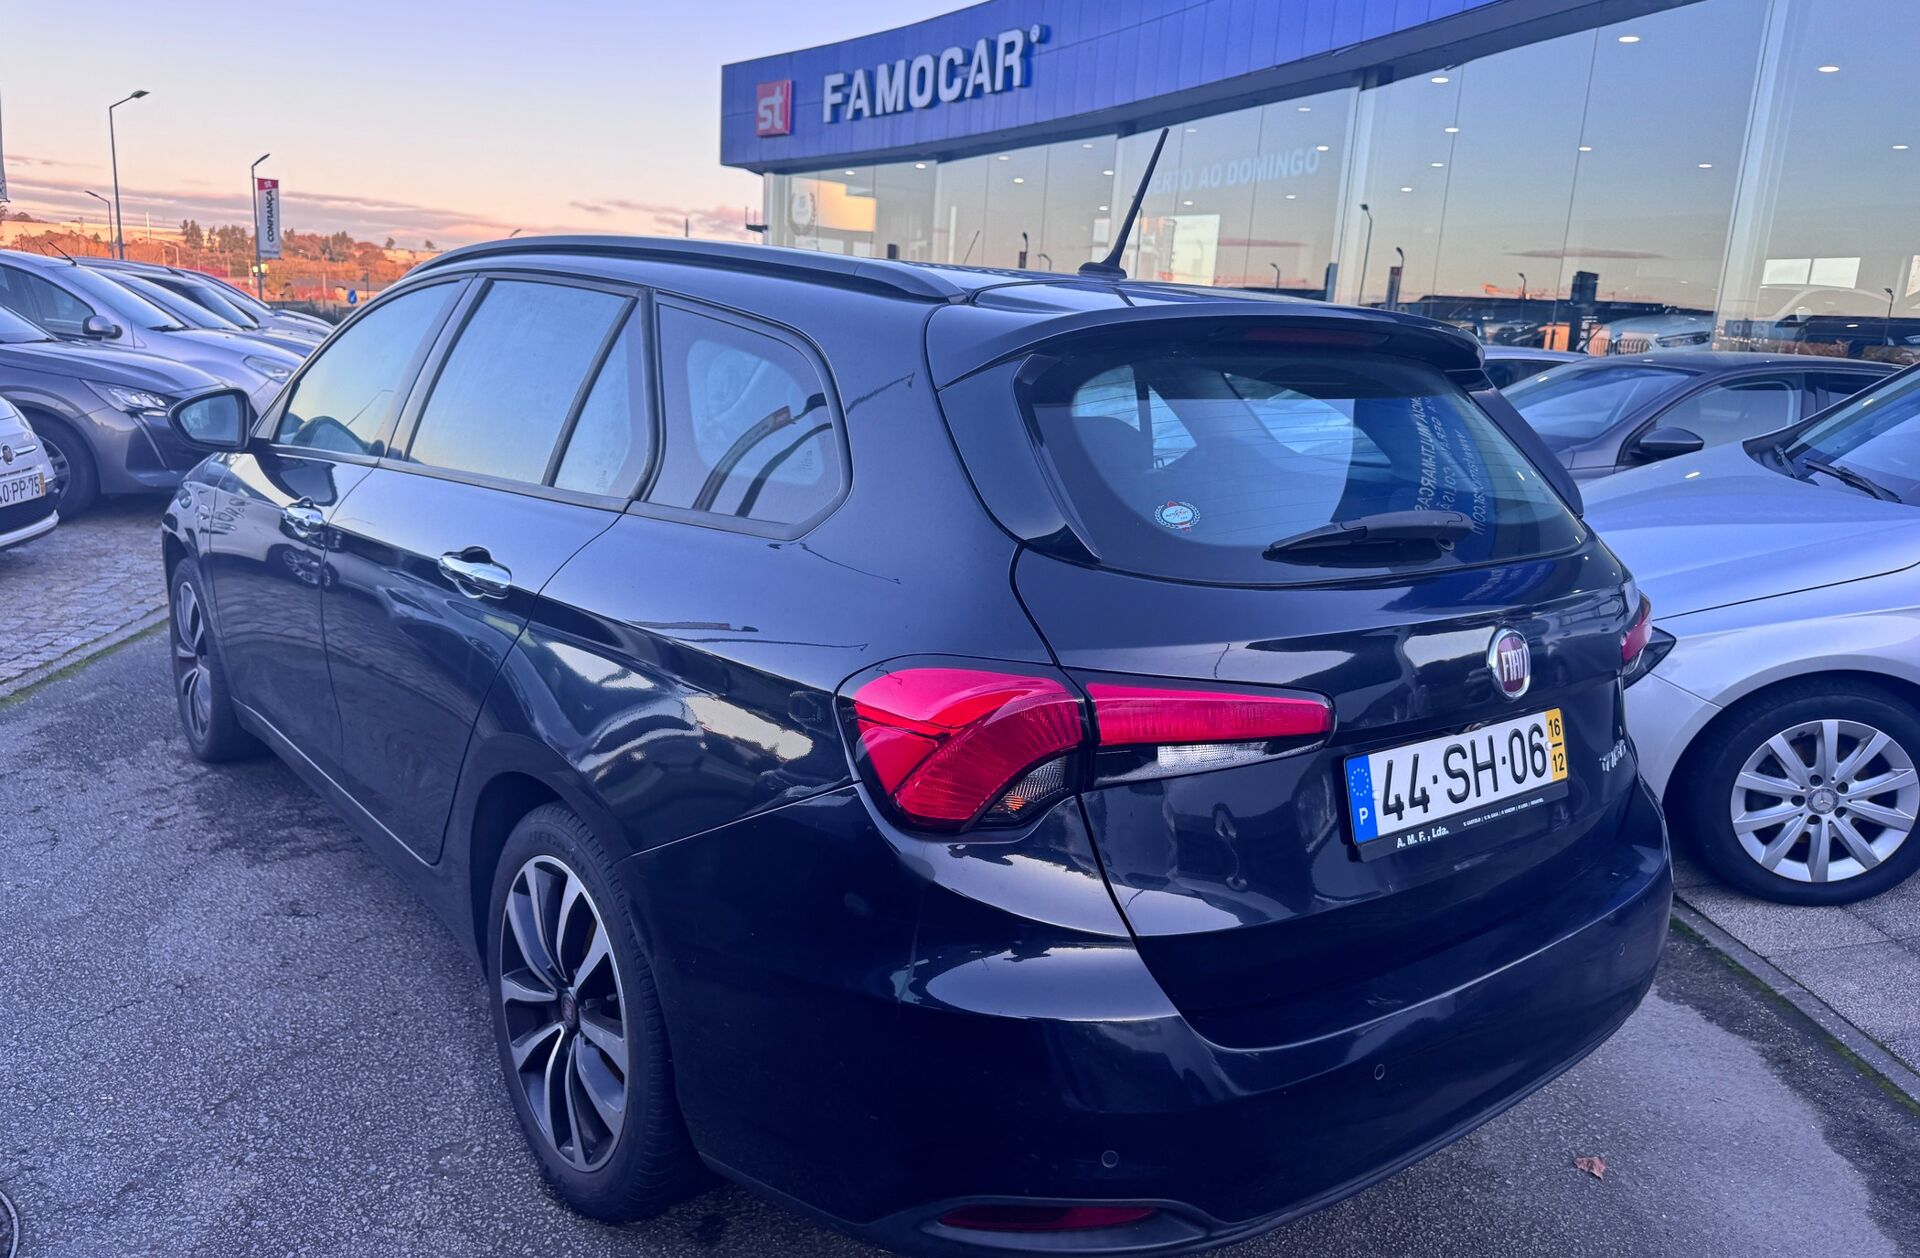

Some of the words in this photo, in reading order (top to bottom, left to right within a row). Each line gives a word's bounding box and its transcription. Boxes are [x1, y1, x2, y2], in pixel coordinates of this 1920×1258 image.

[1199, 164, 1222, 188] AO
[1227, 146, 1321, 186] DOMINGO
[265, 190, 275, 242] CONFIANÇA
[1500, 648, 1523, 682] FIAT
[1548, 718, 1561, 738] 16
[1552, 752, 1565, 773] 12
[1359, 807, 1369, 825] P
[1432, 825, 1449, 839] Lda.
